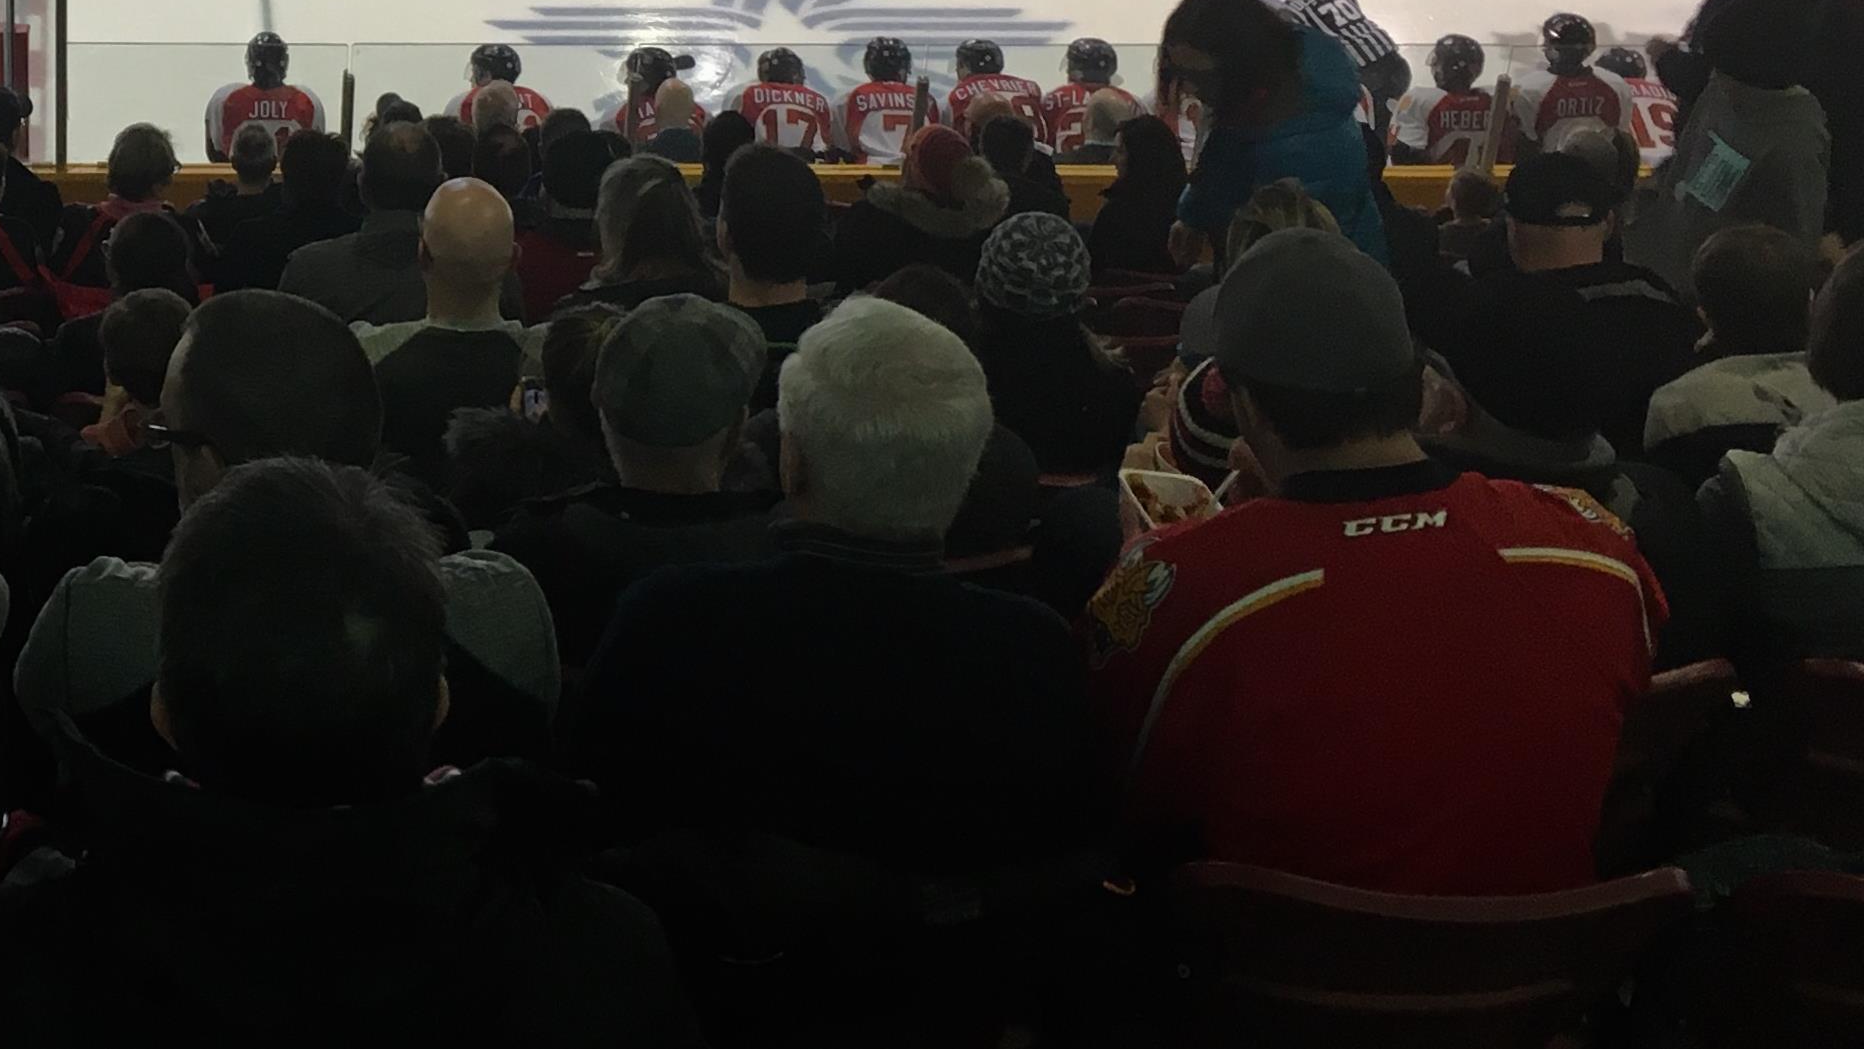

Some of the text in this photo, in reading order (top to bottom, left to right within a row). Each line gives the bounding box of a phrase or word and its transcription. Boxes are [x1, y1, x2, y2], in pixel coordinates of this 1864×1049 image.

[754, 86, 826, 111] DICKNER
[955, 80, 1036, 102] CHEVRIER
[248, 101, 288, 119] JOLY
[1557, 95, 1604, 118] ORTIZ
[761, 108, 819, 149] 17
[1342, 509, 1447, 538] CCM
